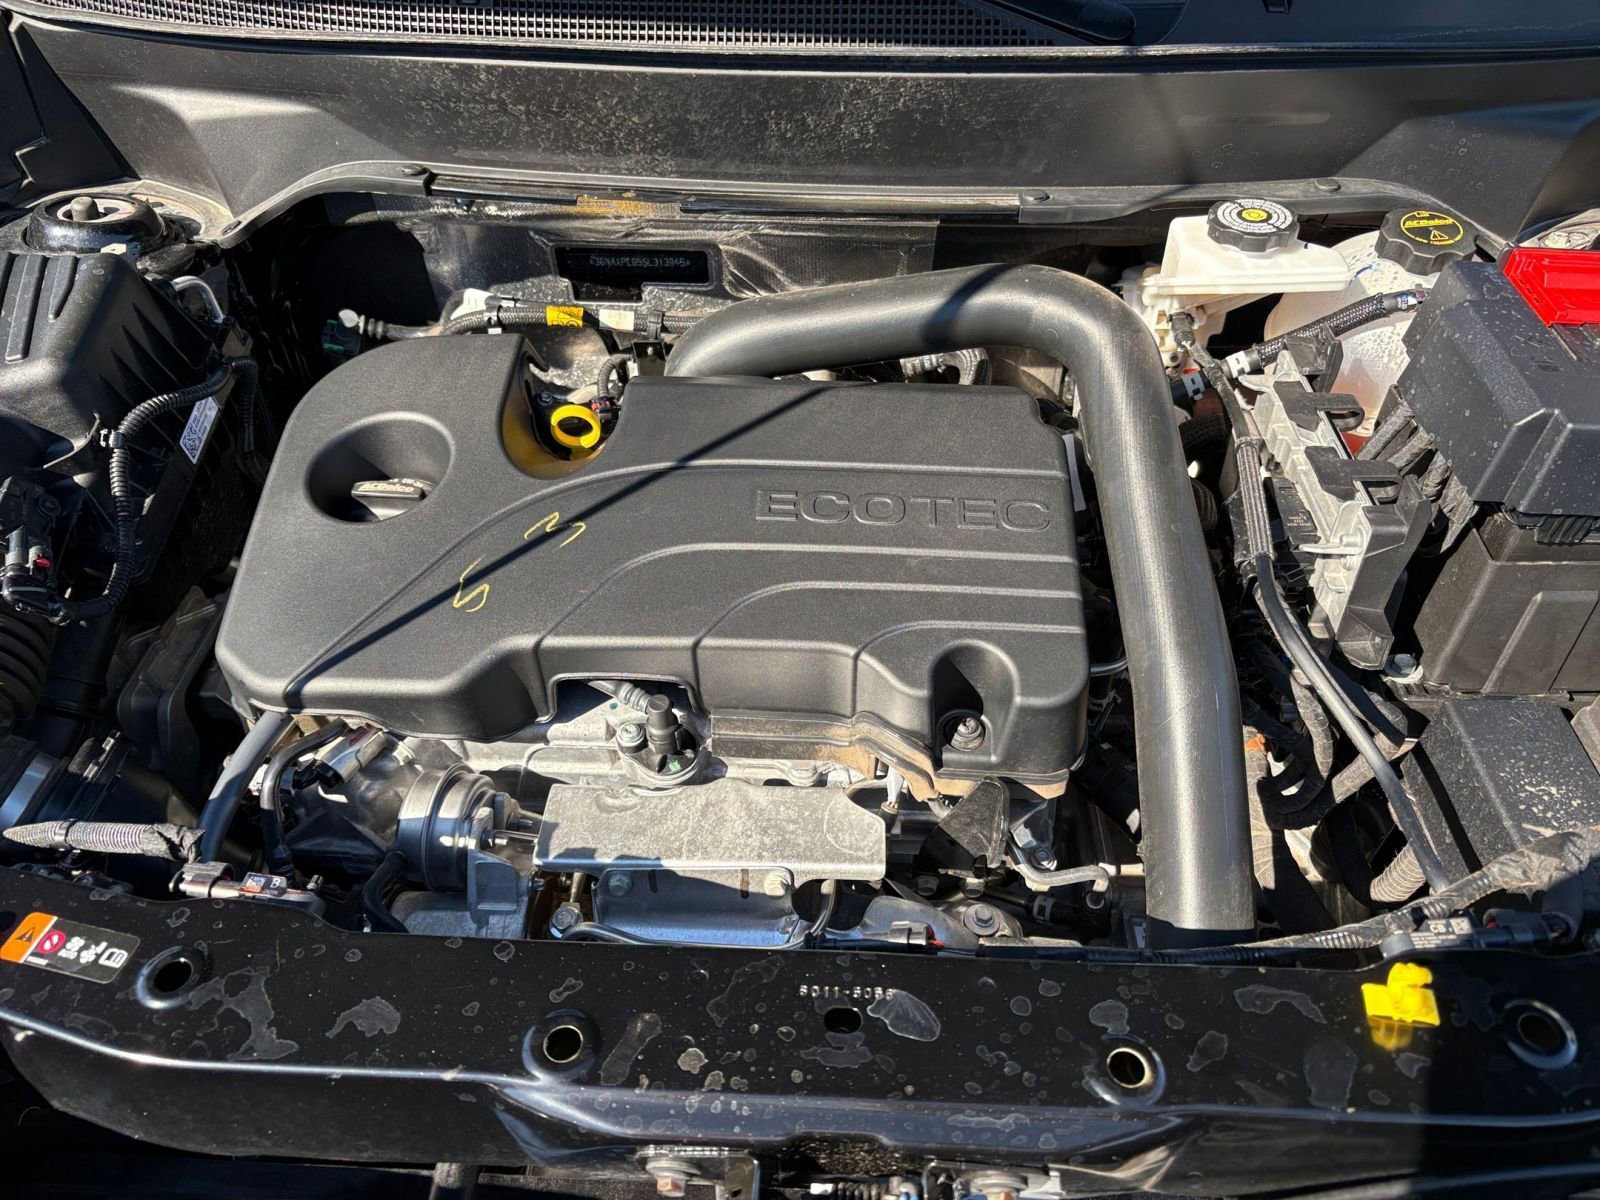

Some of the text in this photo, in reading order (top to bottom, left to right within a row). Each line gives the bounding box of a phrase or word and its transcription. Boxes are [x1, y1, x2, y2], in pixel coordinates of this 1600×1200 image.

[1403, 218, 1454, 228] ACDelco
[358, 482, 415, 492] ACDelco
[755, 489, 1051, 533] ECOTEC
[270, 877, 281, 889] B
[57, 948, 79, 960] AUTO
